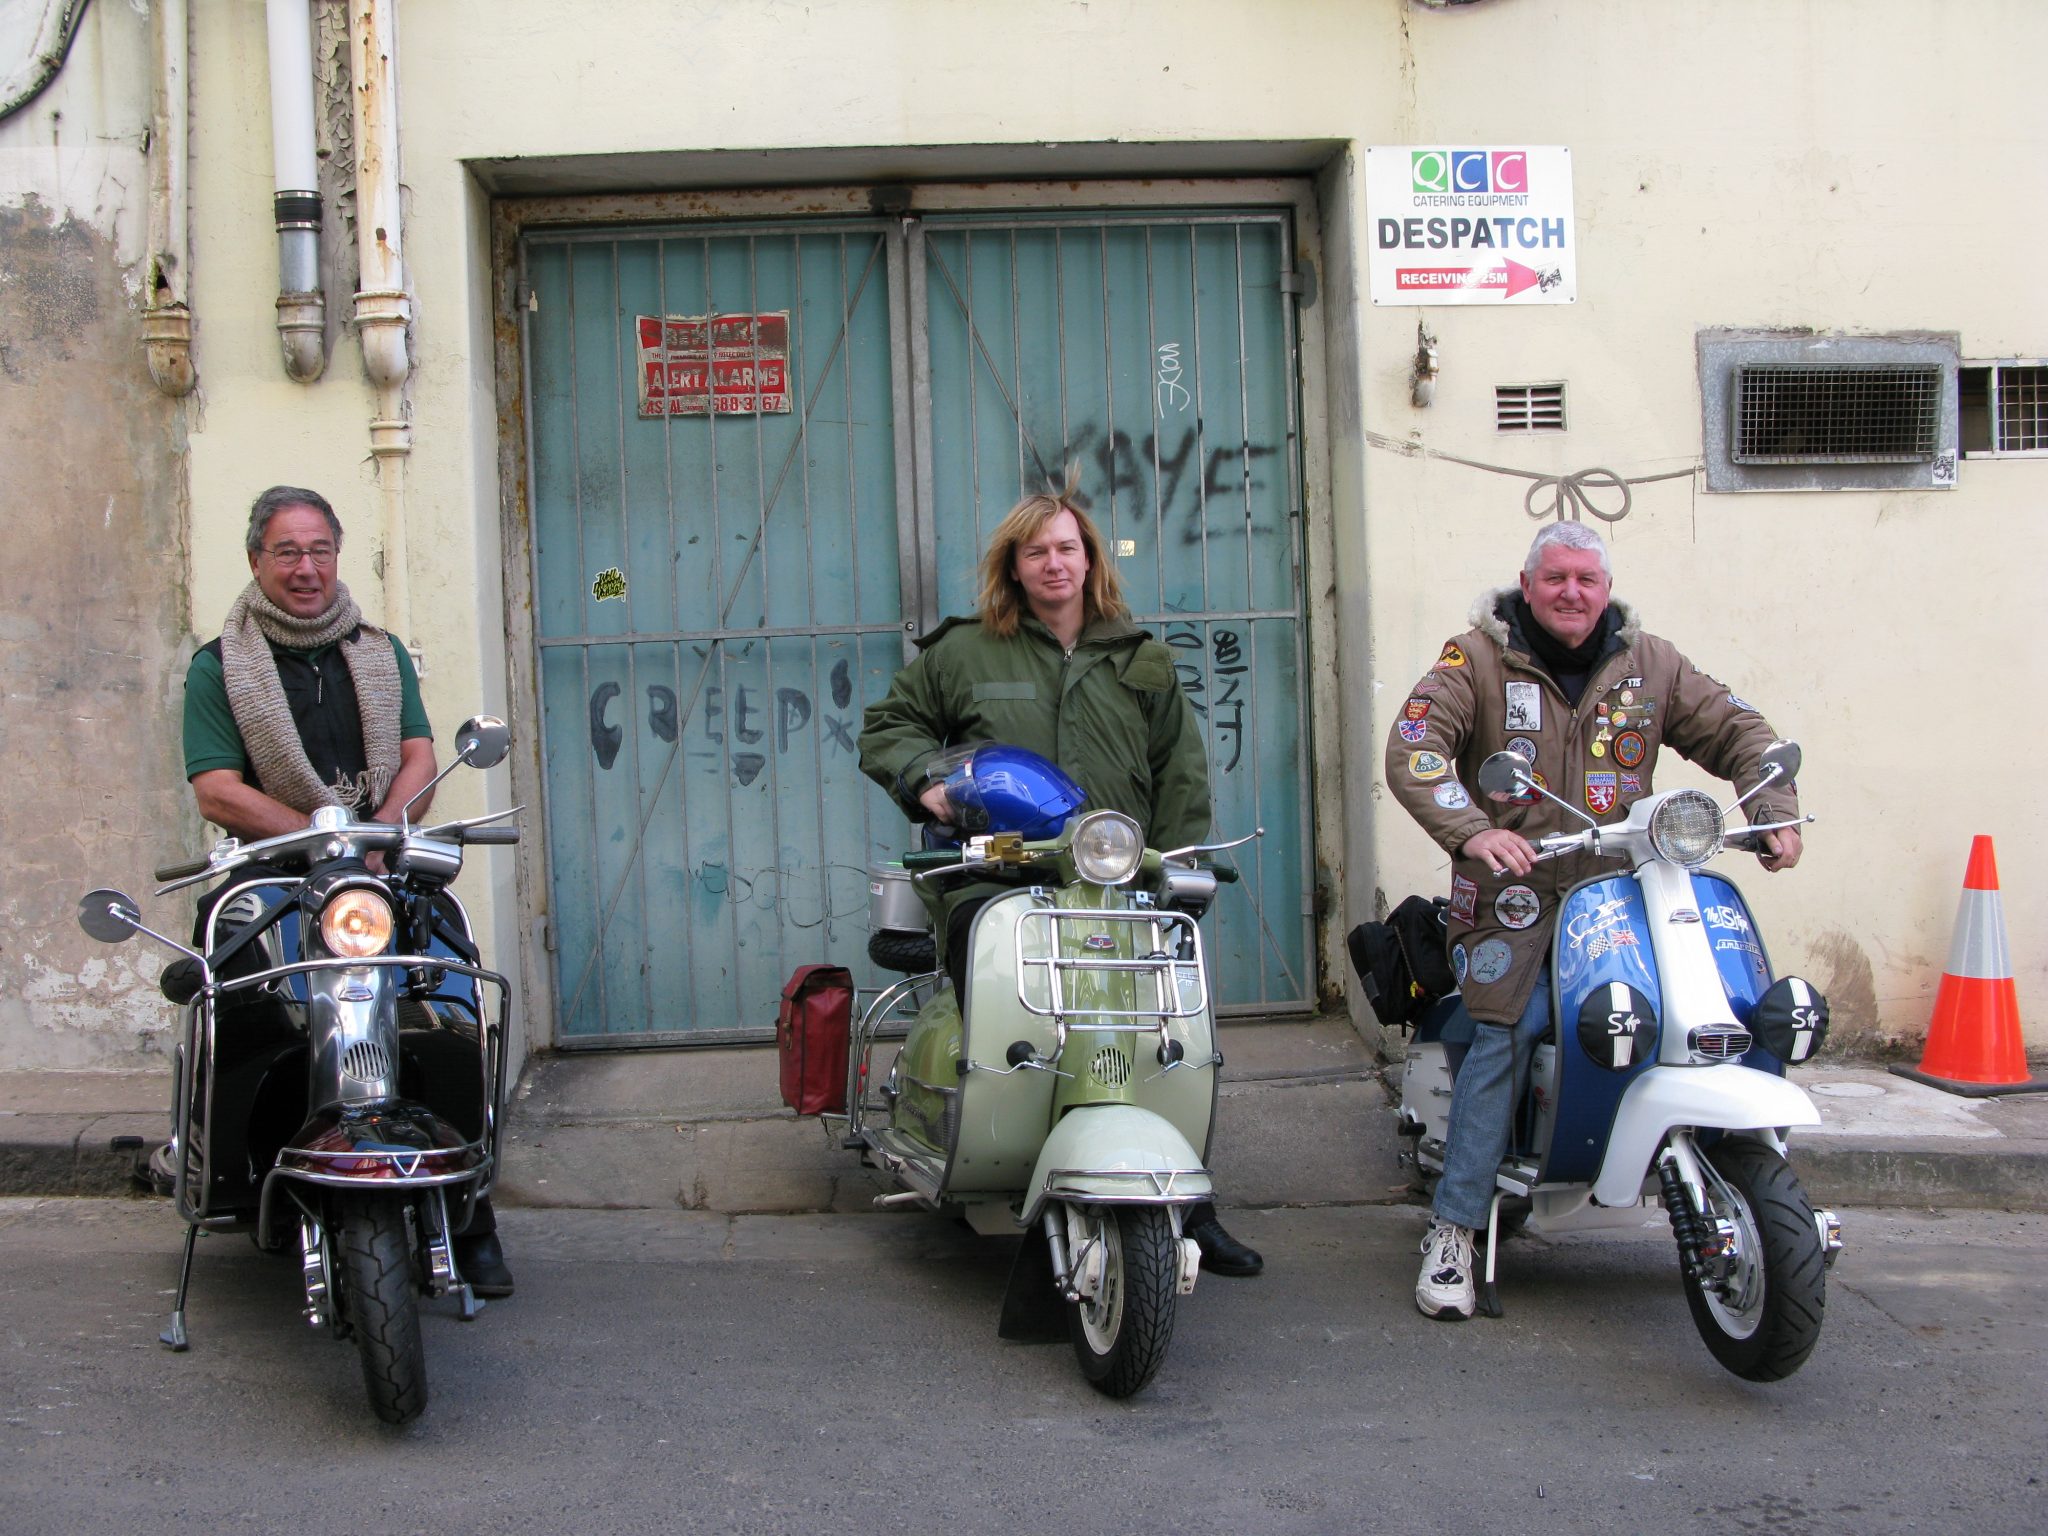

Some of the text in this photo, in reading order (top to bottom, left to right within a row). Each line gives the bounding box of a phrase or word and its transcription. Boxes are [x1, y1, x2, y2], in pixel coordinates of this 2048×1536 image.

[1413, 152, 1525, 192] QCC
[1413, 194, 1529, 207] CATERING EQUIPMENT
[1378, 217, 1565, 249] DESPATCH
[652, 366, 780, 390] ALERT ALARMS
[1416, 760, 1442, 771] LOTUS
